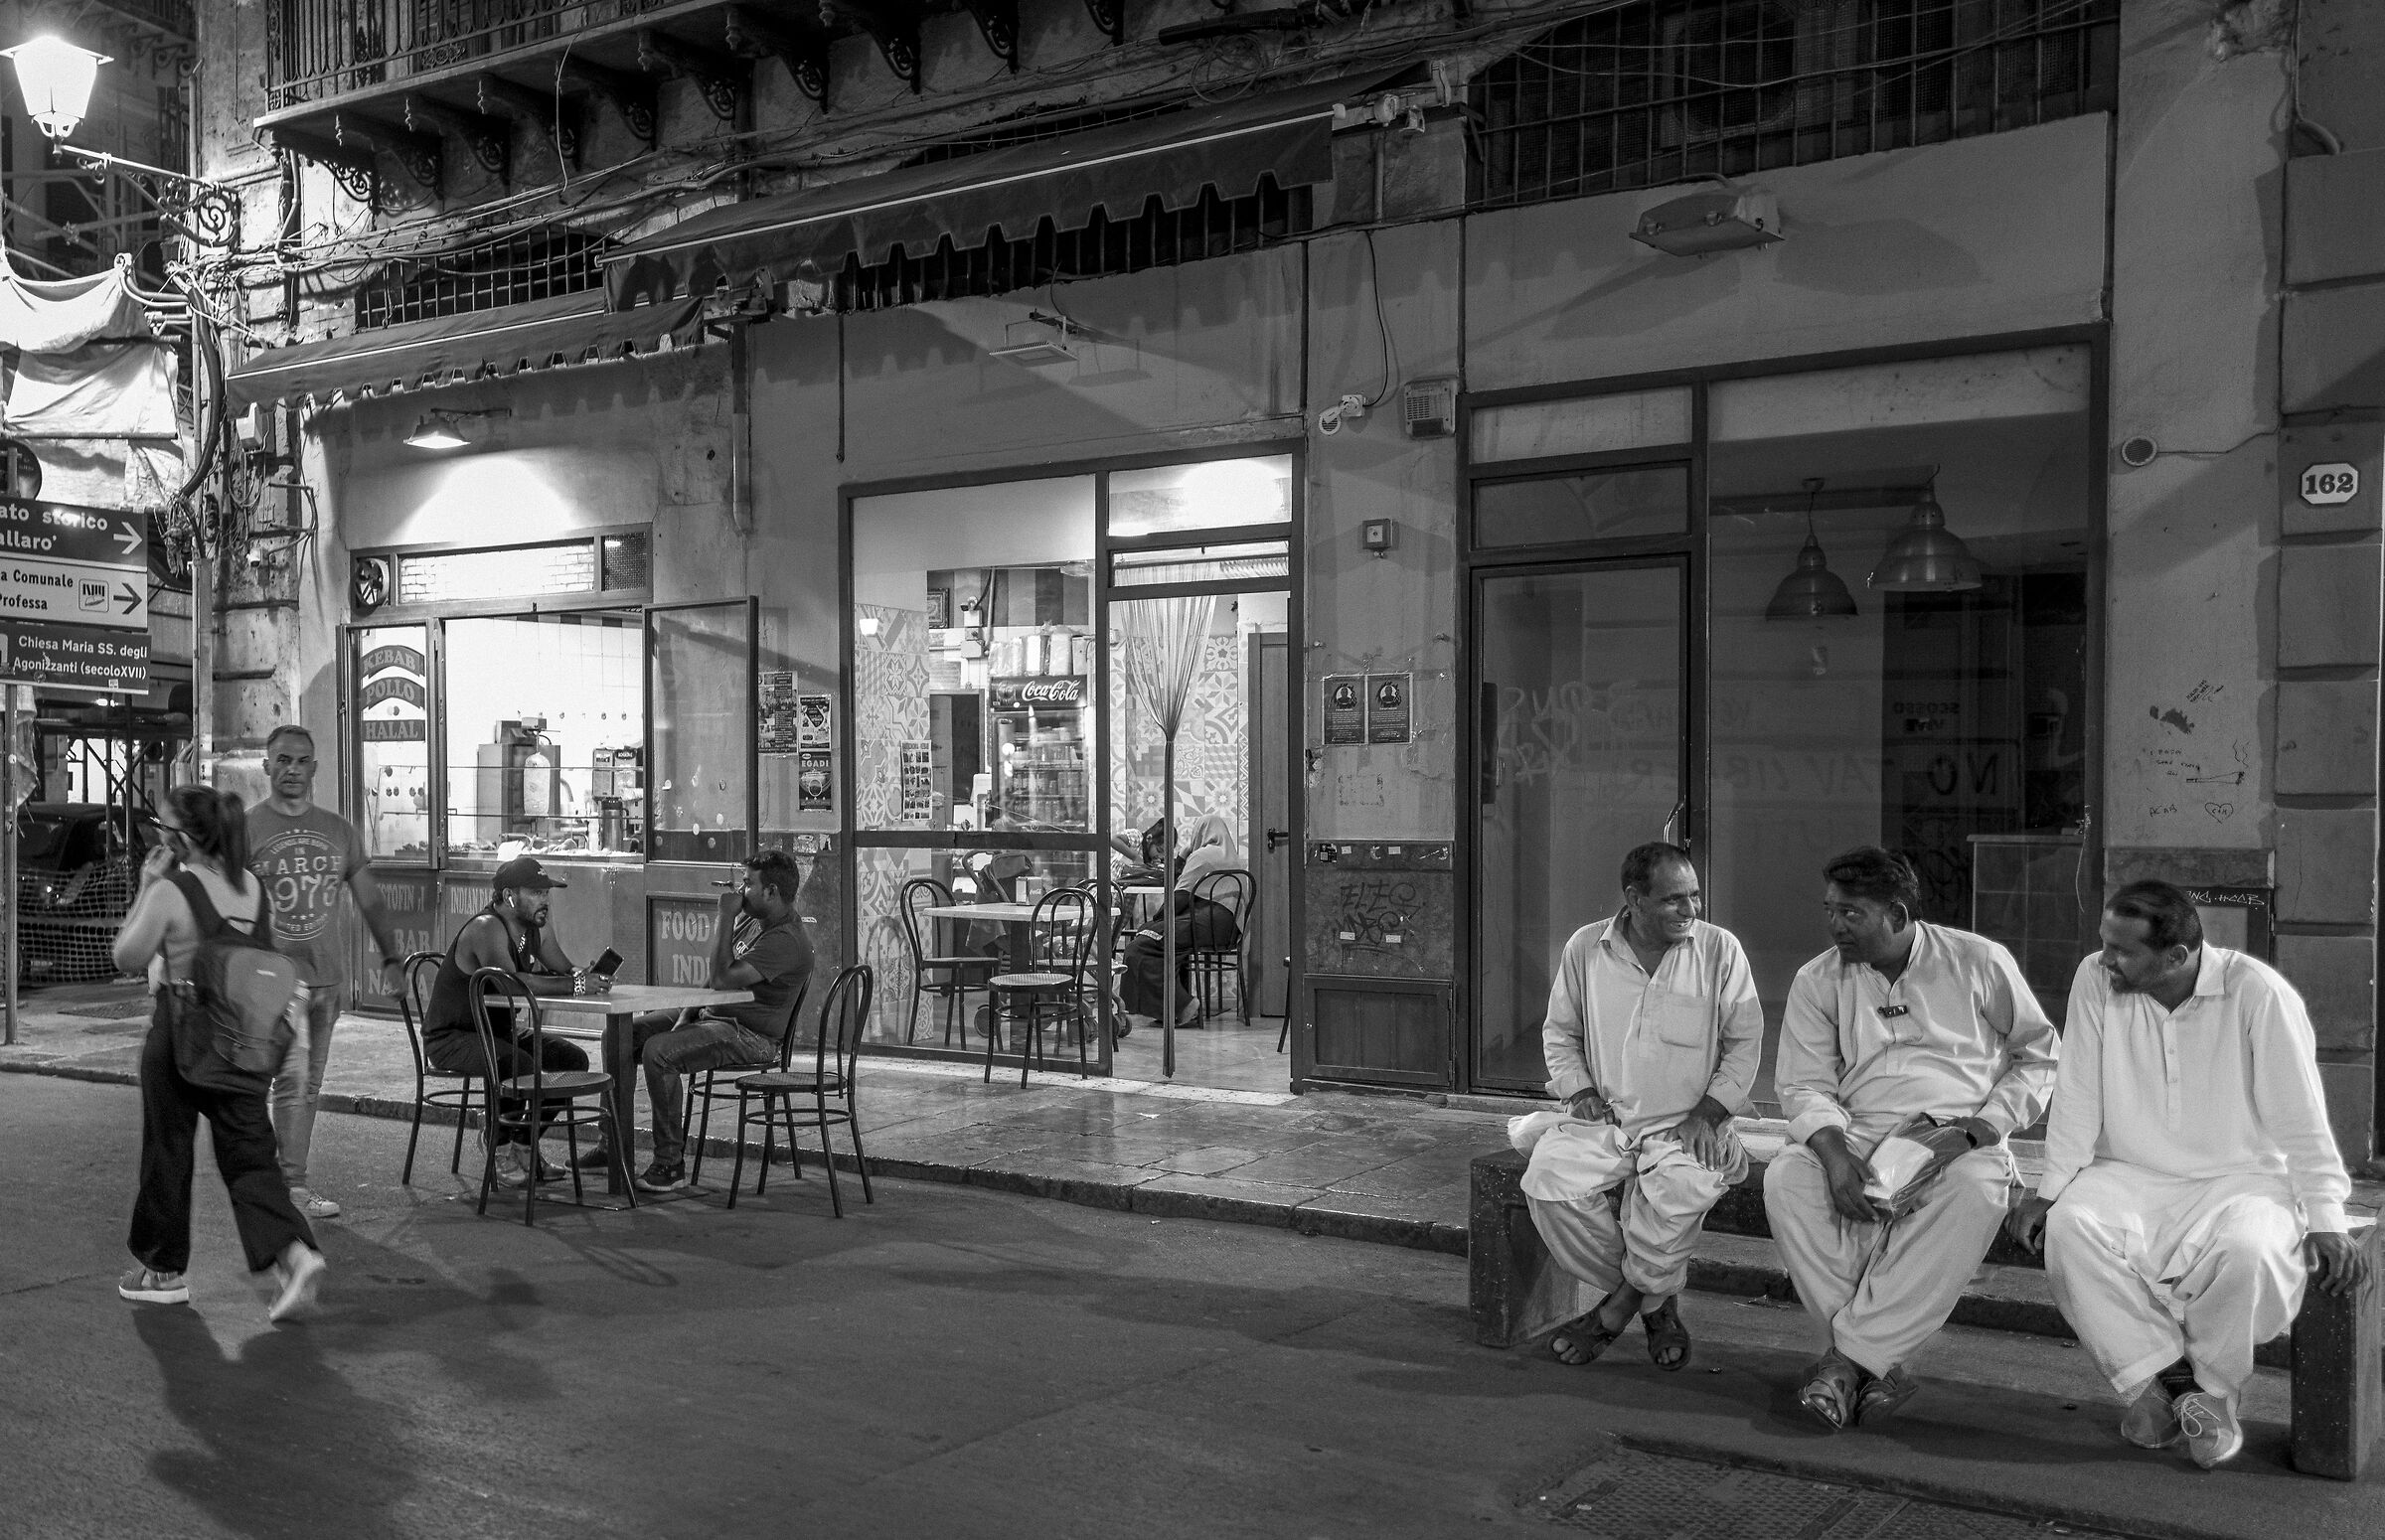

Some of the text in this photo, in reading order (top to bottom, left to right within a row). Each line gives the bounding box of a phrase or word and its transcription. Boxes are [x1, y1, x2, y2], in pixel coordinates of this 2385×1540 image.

[2306, 473, 2354, 495] 162
[42, 509, 108, 531] storico
[13, 569, 74, 588] Comunale
[19, 636, 148, 660] Chiesa Maria SS. degli
[14, 657, 146, 680] Agonizzanti (secoloXVII)
[364, 649, 416, 675] KEBAB
[366, 680, 415, 704] POLLO
[1022, 680, 1081, 701] Coca-Cola
[366, 721, 417, 739] HALAL
[801, 759, 829, 768] EGADI
[661, 911, 711, 942] FOOD
[672, 954, 711, 987] INDI
